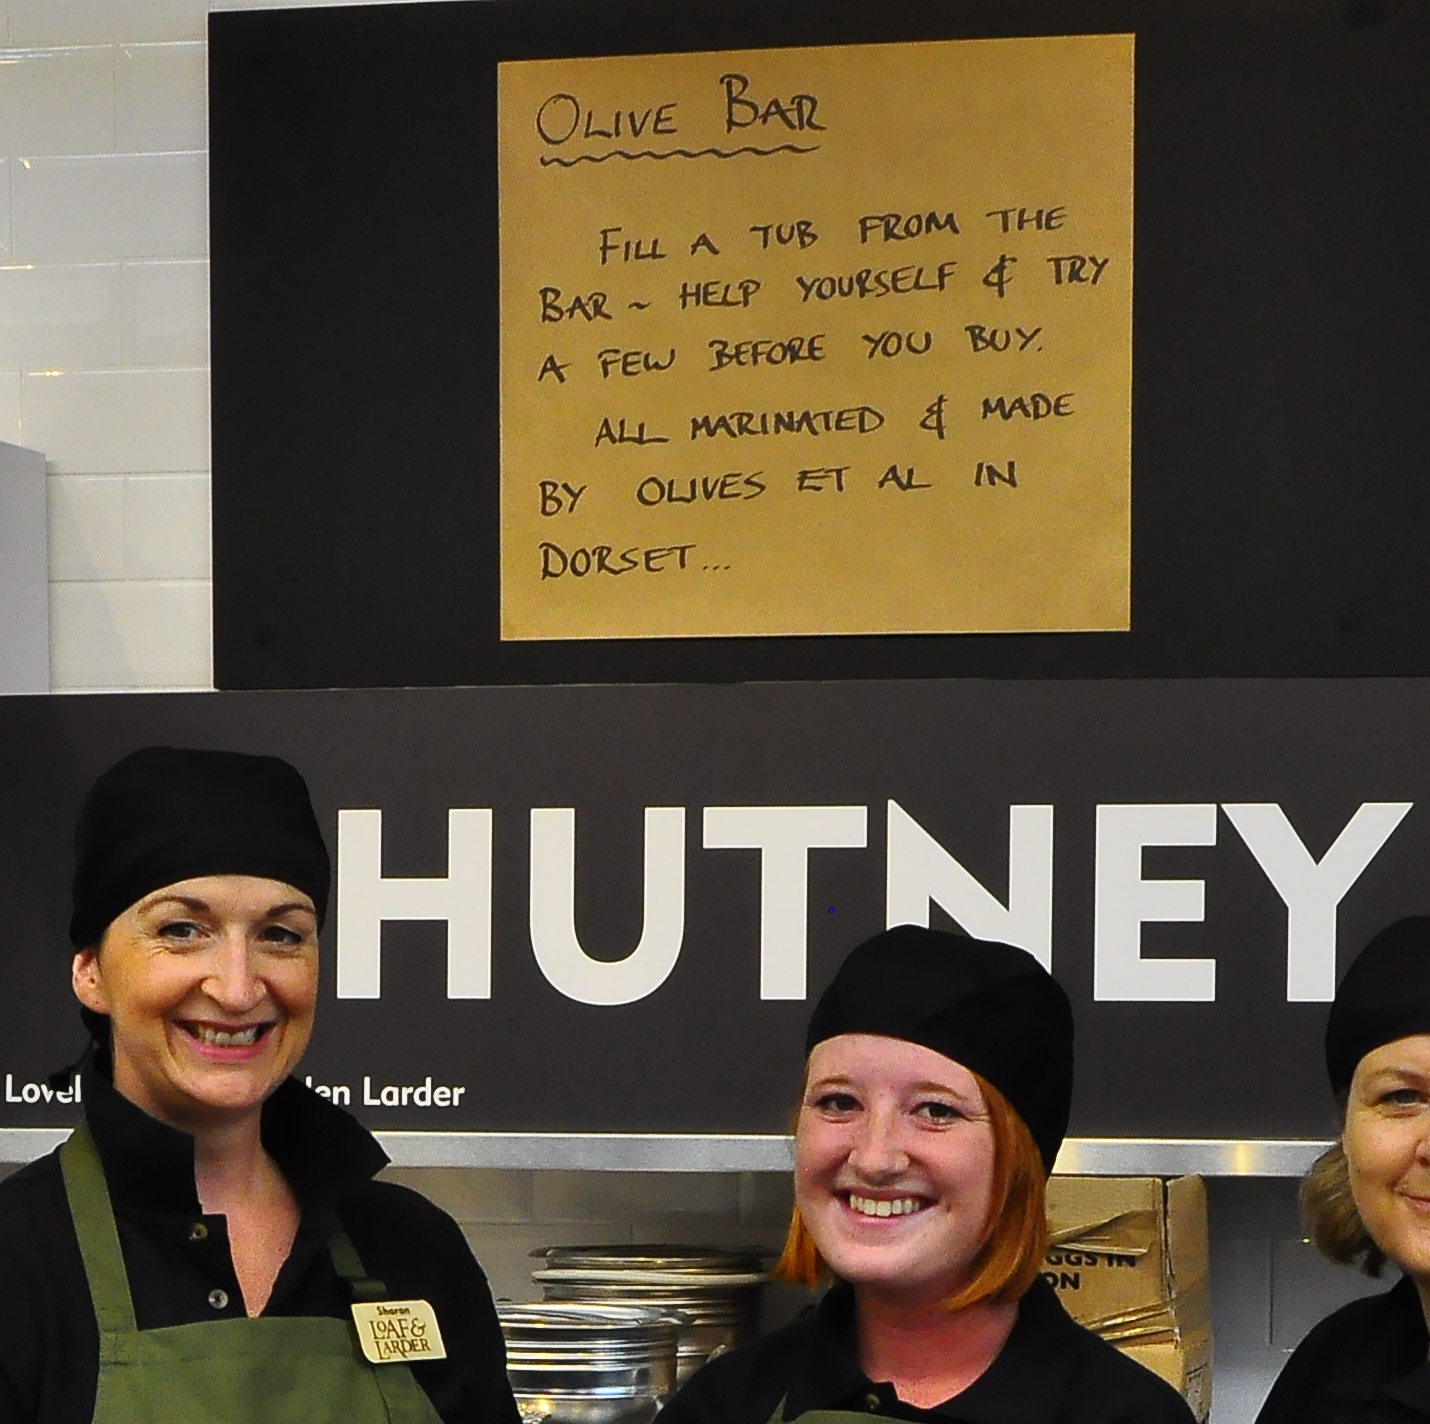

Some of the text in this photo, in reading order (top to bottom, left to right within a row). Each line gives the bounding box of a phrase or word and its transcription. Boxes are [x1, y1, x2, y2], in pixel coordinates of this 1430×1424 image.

[536, 73, 827, 145] OLIVE BAR
[599, 206, 1066, 265] FILL A TUB FROM THE
[679, 279, 761, 310] HELP
[796, 261, 957, 302] YOURSELF
[983, 255, 1014, 298] &
[1050, 254, 1110, 287] TRY
[537, 324, 1043, 384] A FEW BEFORE YOU BUY.
[595, 392, 1074, 448] ALL MARINATED & MADE
[539, 460, 1018, 517] BY OLIVES ET AL IN
[336, 799, 1414, 1006] HUTNEY
[5, 1074, 83, 1104] Lovel
[363, 1077, 466, 1108] Larder
[376, 1306, 410, 1316] Sharon
